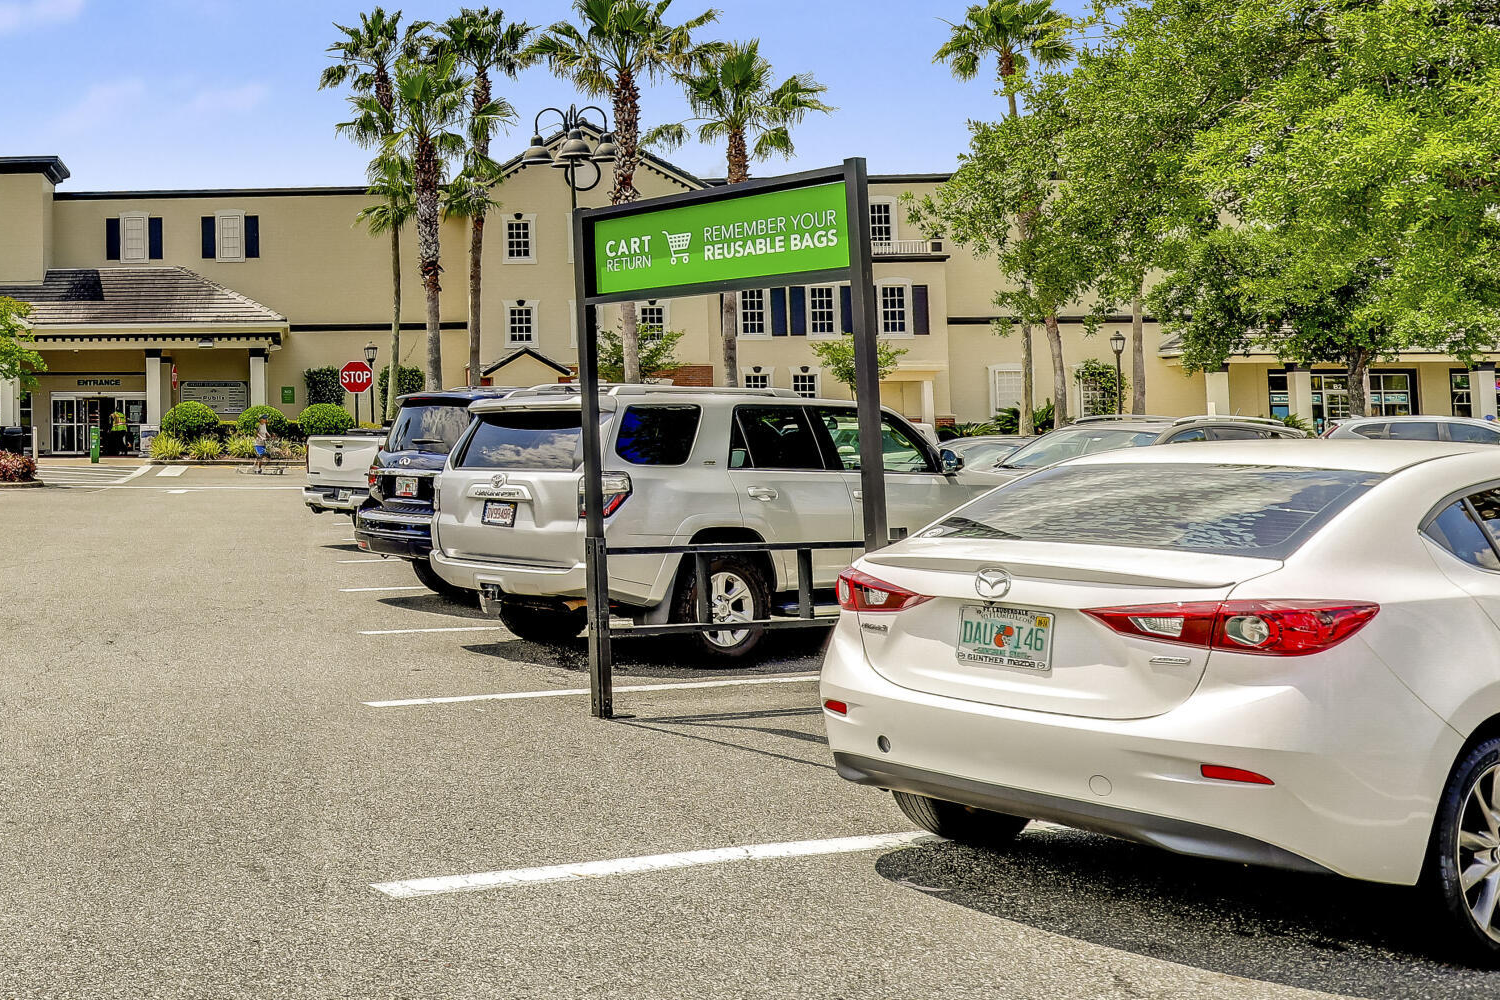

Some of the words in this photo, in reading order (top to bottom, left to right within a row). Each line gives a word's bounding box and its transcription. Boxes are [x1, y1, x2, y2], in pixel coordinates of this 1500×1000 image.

[703, 216, 787, 243] REMEMBER
[790, 209, 837, 231] YOUR
[605, 235, 653, 258] CART
[704, 234, 786, 262] REUSABLE
[790, 228, 839, 251] BAGS
[606, 254, 653, 273] RETURN
[342, 370, 372, 384] STOP
[963, 620, 993, 645] DAU
[967, 653, 1004, 665] GUNTHER
